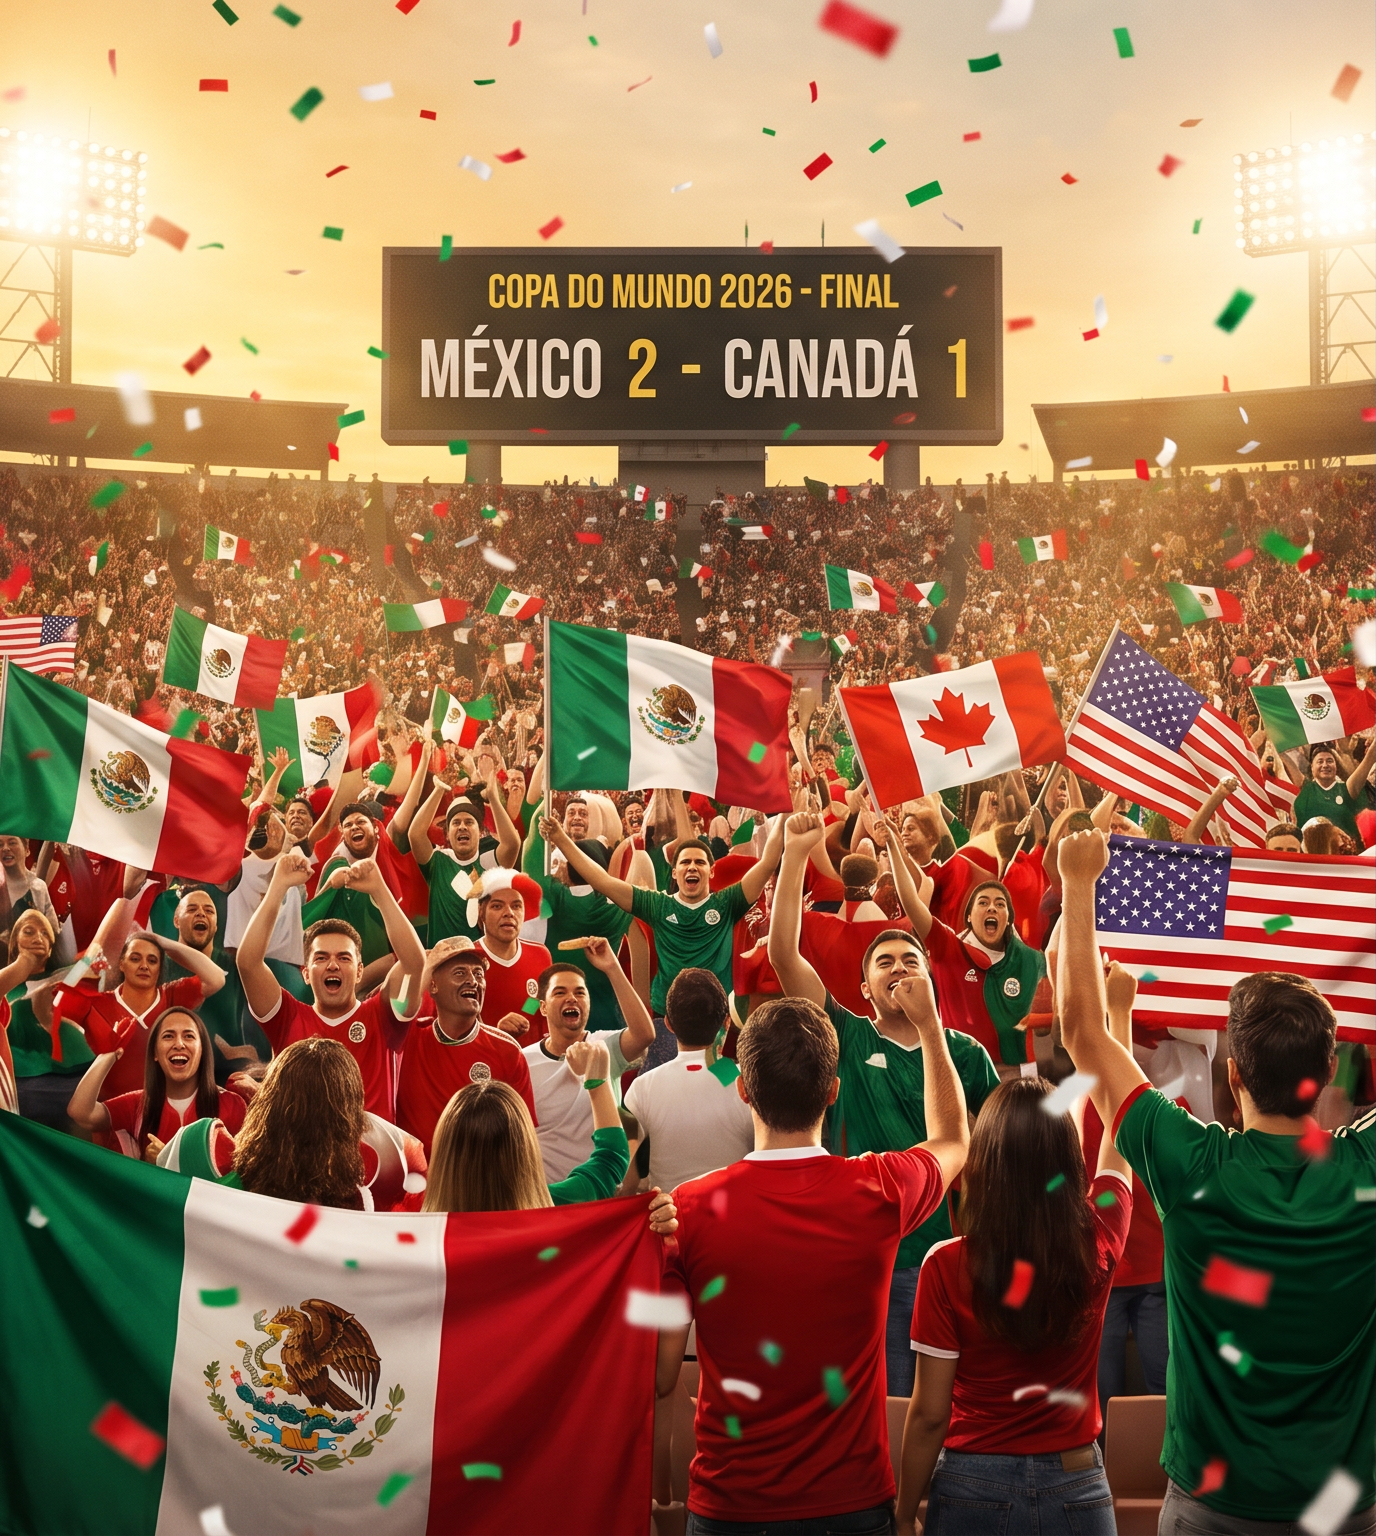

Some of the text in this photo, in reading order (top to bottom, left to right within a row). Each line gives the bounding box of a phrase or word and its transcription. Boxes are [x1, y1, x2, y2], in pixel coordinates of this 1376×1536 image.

[488, 273, 560, 309] COPA
[567, 273, 604, 309] DO
[612, 273, 712, 309] MUNDO
[720, 273, 793, 309] 2026
[820, 273, 900, 309] FINAL
[420, 324, 968, 399] MÉXICO 2 - CANADÁ 1
